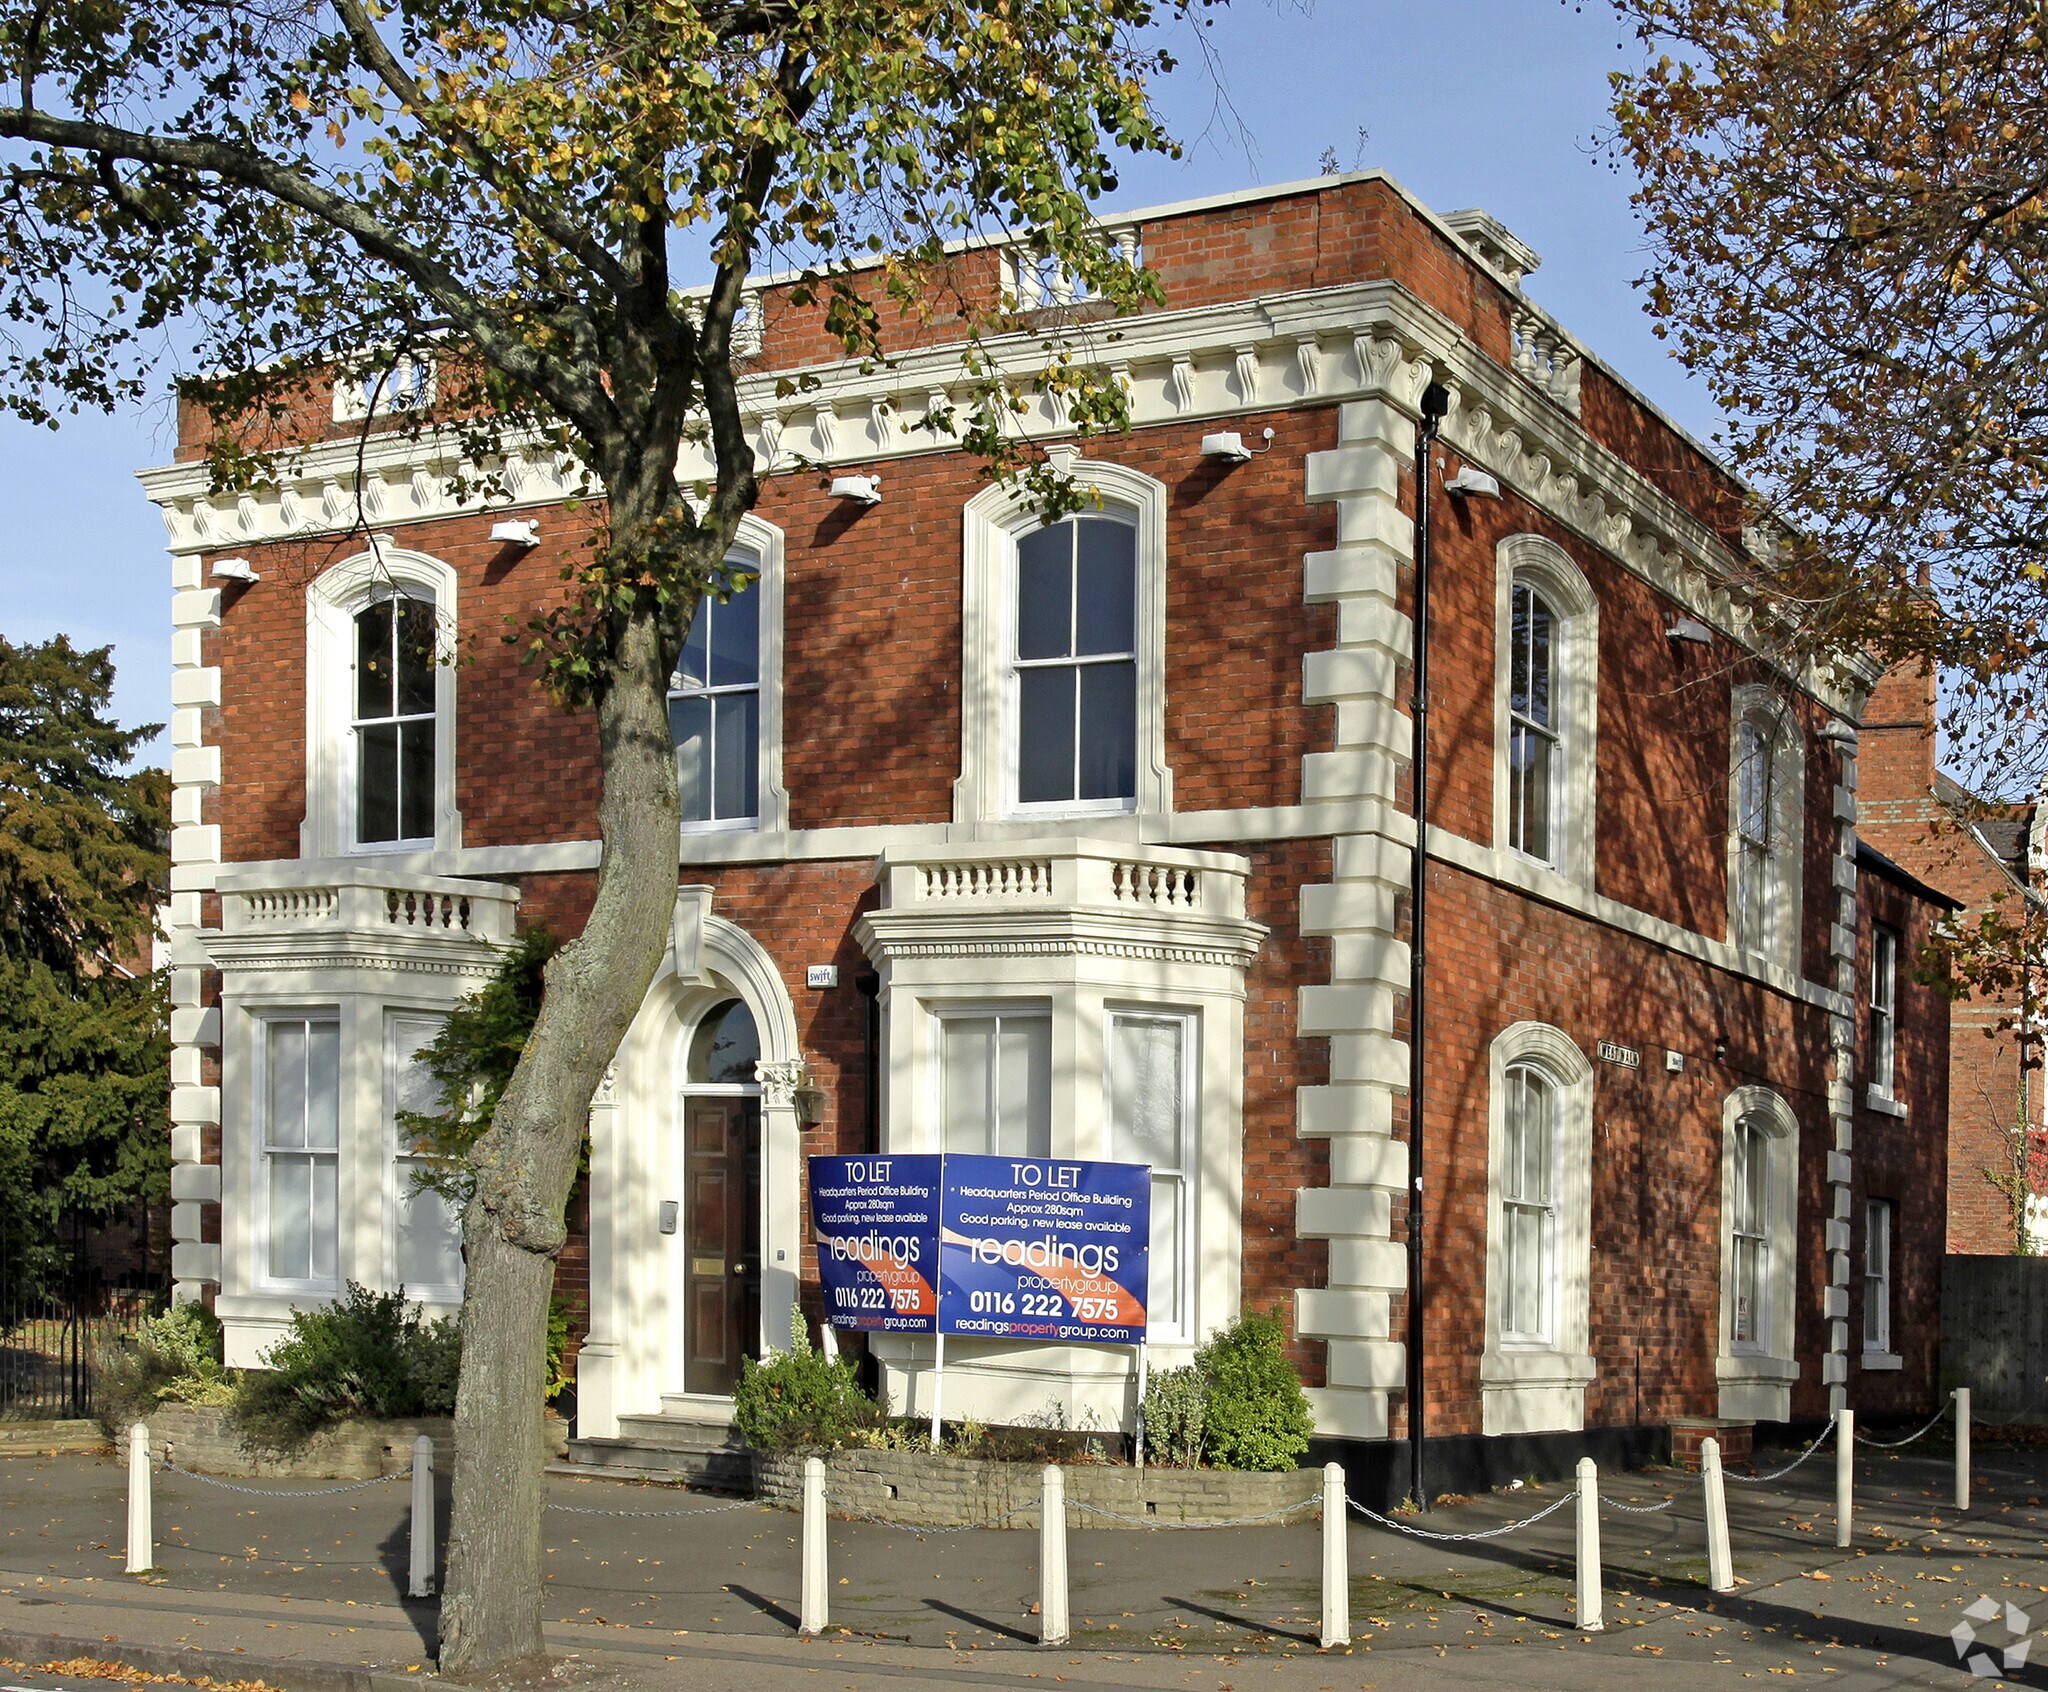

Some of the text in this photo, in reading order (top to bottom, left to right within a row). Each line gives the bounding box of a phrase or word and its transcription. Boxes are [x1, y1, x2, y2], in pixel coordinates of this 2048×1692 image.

[810, 969, 831, 983] swift
[845, 1161, 893, 1183] TO LET
[1011, 1163, 1082, 1189] TO LET
[818, 1185, 929, 1198] Headquarters Period Office Building
[960, 1186, 1133, 1208] Headquarters Period Office Building
[845, 1199, 895, 1211] Approx 280sqm
[1006, 1202, 1084, 1218] Approx 280sqm
[822, 1213, 837, 1223] Good
[861, 1214, 876, 1223] new
[876, 1213, 894, 1223] lease
[895, 1213, 928, 1223] available
[959, 1213, 989, 1225] Good
[1032, 1218, 1055, 1228] new
[1056, 1218, 1083, 1230] lease
[1084, 1220, 1132, 1234] available
[830, 1229, 920, 1270] readings
[971, 1234, 1120, 1279] readings
[856, 1269, 920, 1286] propertygroup
[1017, 1275, 1119, 1295] propertygroup
[835, 1286, 920, 1310] 0116 222 7575
[970, 1290, 1119, 1321] 0116 222 7575
[831, 1314, 927, 1330] readingspropertygroup.com
[955, 1318, 1130, 1340] readingspropertygroup.com
